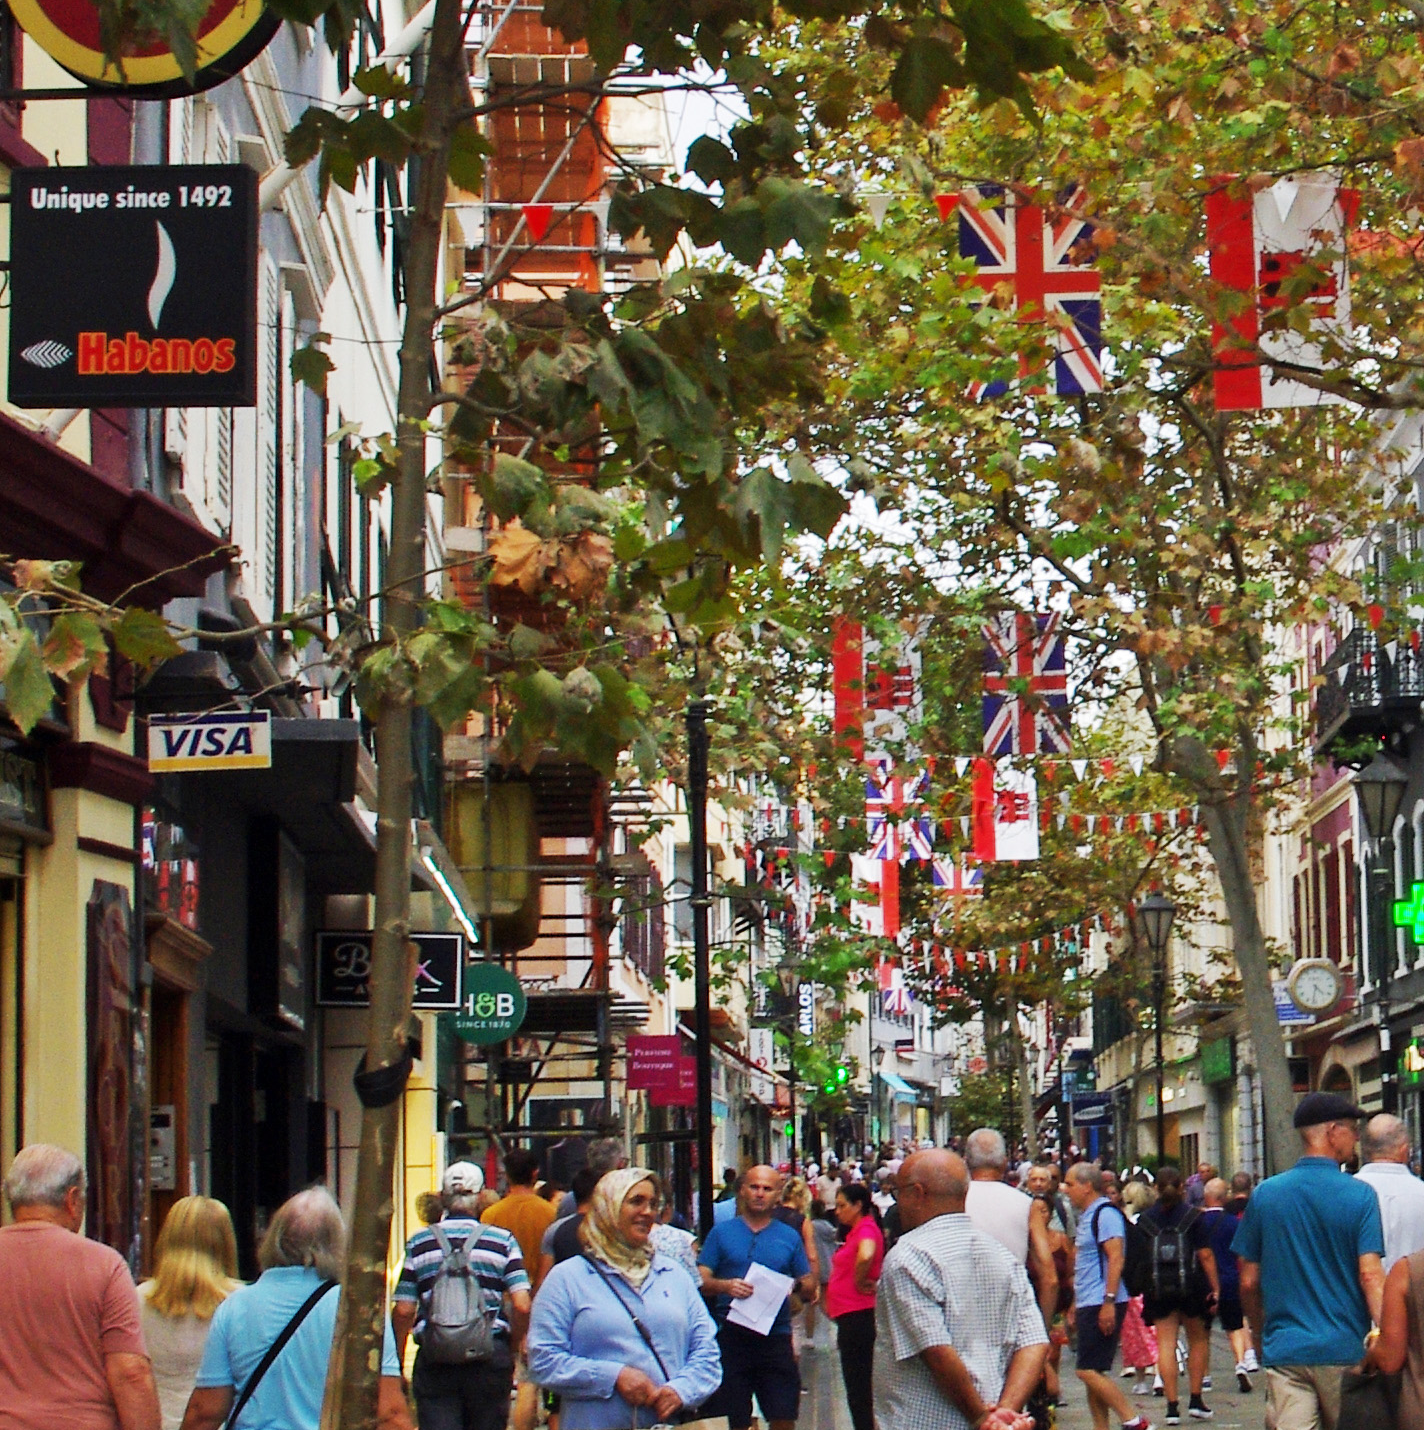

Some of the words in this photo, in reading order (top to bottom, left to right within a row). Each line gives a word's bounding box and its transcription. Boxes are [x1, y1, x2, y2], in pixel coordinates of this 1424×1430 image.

[30, 186, 110, 213] Unique
[115, 185, 170, 208] since
[178, 185, 232, 208] 1492
[78, 332, 236, 375] Habanos
[162, 727, 253, 757] VISA
[455, 992, 515, 1018] H&B
[798, 983, 814, 1046] ARLOS
[456, 1021, 487, 1029] SINCE
[488, 1020, 511, 1029] 1870
